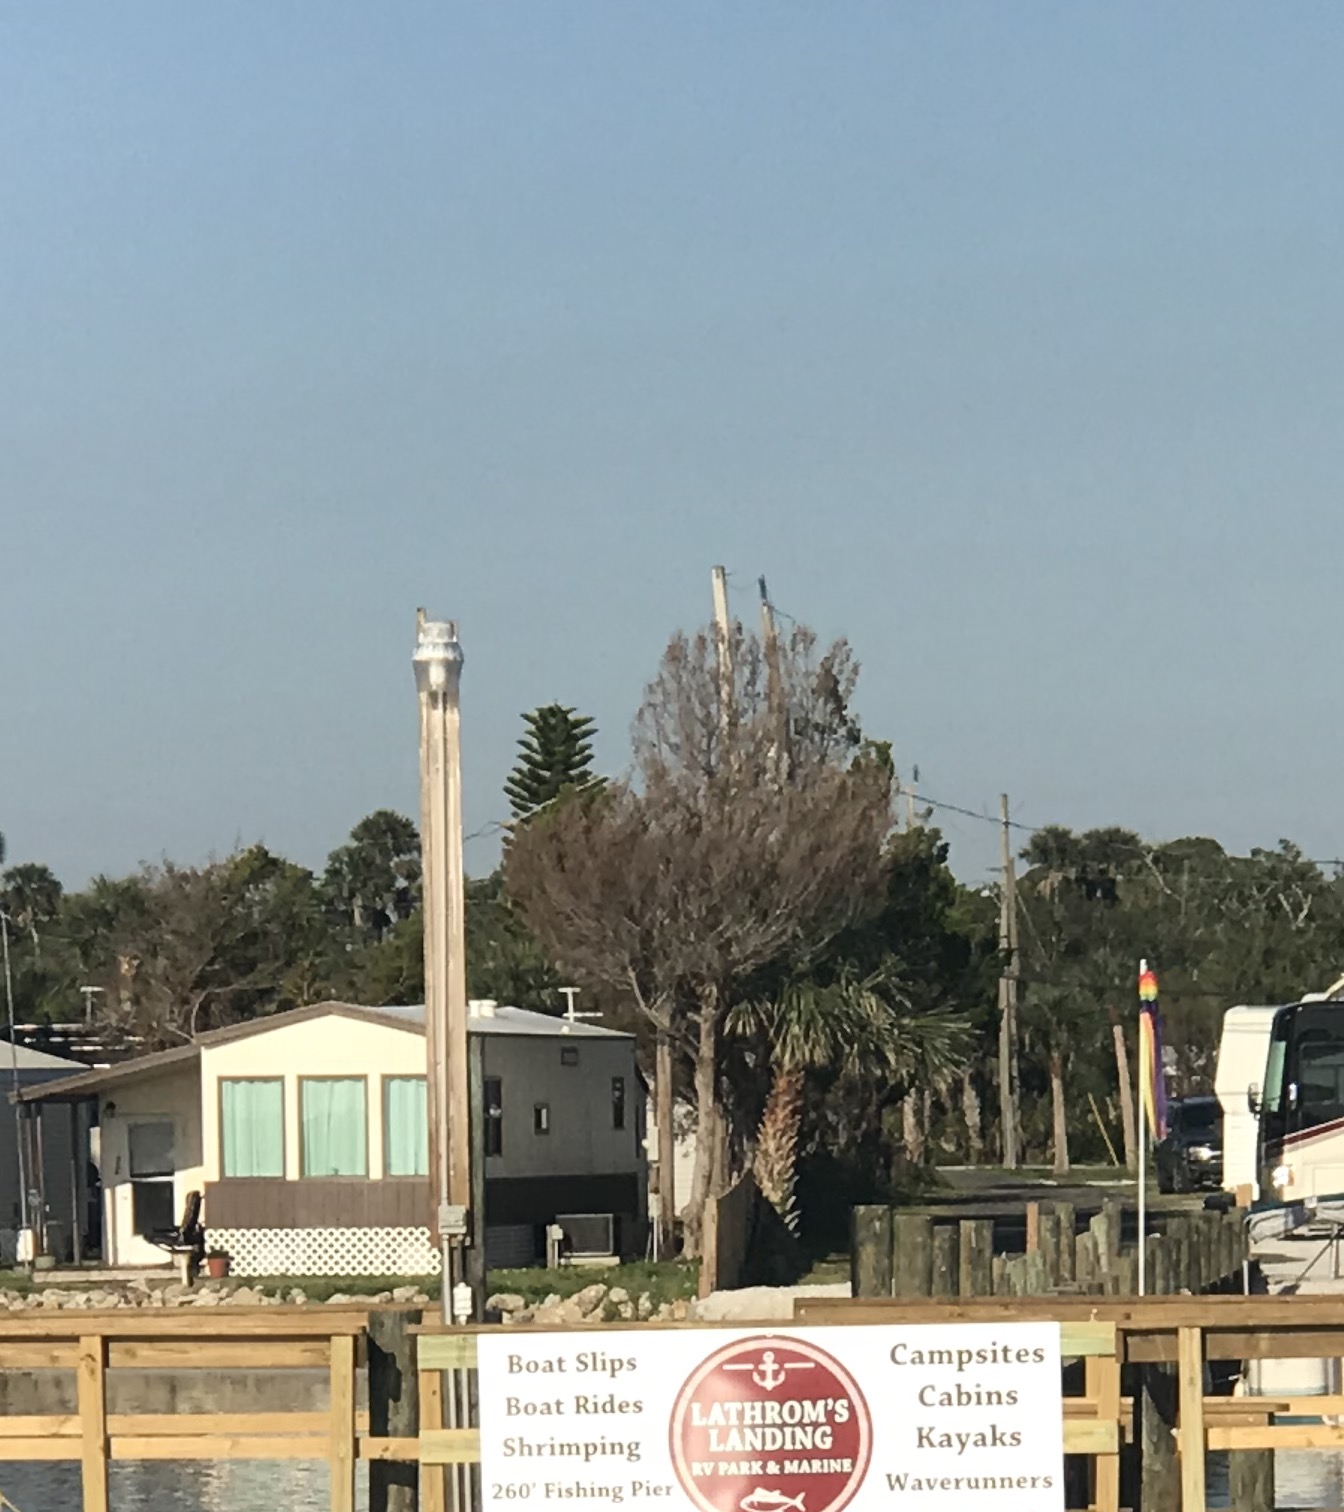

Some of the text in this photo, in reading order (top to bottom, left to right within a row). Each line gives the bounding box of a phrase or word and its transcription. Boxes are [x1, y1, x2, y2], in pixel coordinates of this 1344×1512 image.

[508, 1351, 637, 1378] Boat Slips
[890, 1341, 1045, 1372] Campsites
[506, 1394, 643, 1416] Boat Rides
[918, 1383, 1018, 1407] Cabins
[691, 1398, 849, 1426] LATHROM'S
[503, 1435, 641, 1463] Shrimping
[708, 1426, 833, 1452] LANDING
[916, 1424, 1022, 1455] Kayaks
[692, 1459, 852, 1476] RV PARK & MARINE
[544, 1481, 624, 1503] Fishing
[631, 1480, 673, 1497] Pier
[886, 1473, 1053, 1492] Waverunners
